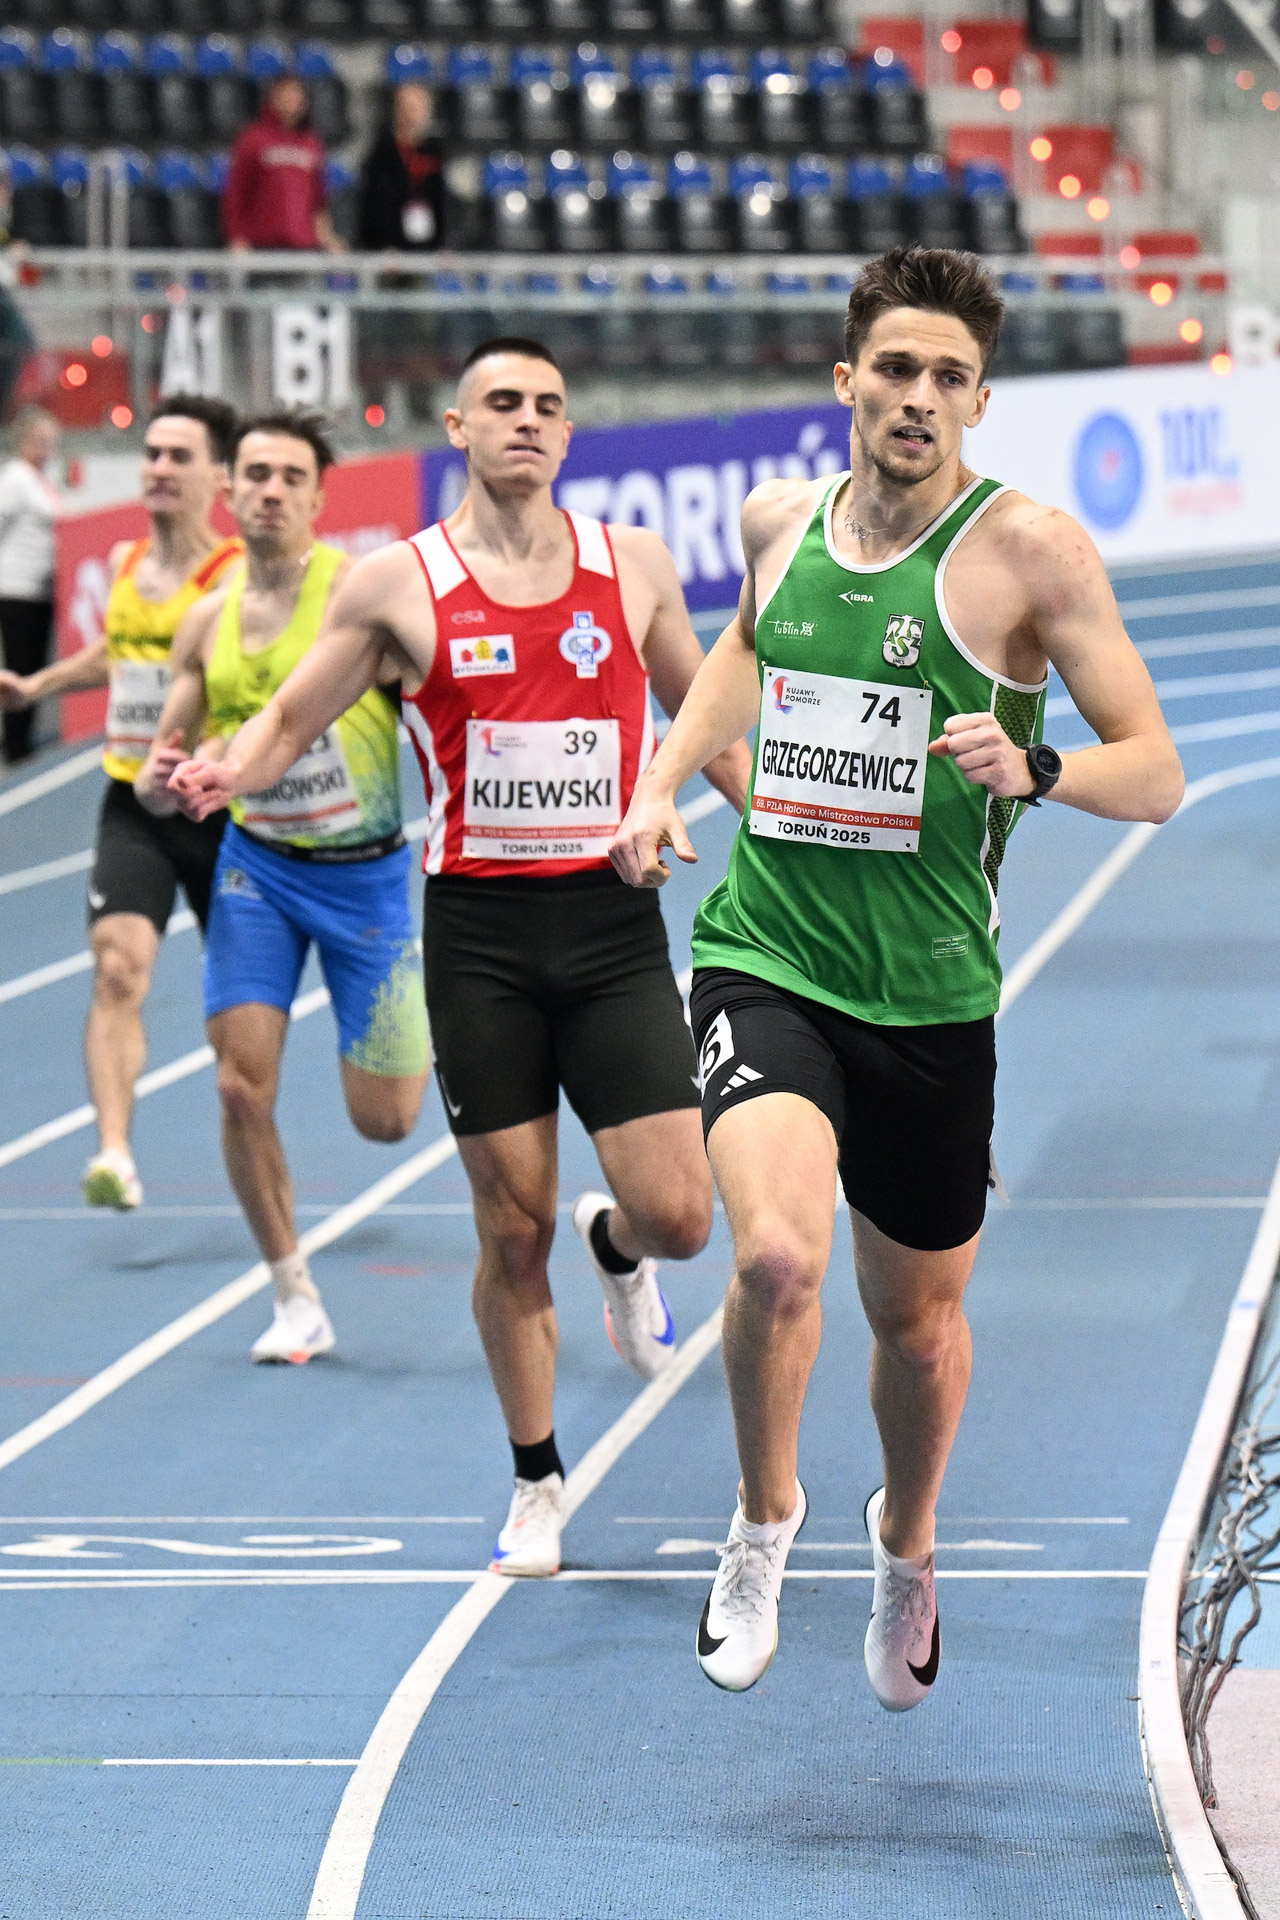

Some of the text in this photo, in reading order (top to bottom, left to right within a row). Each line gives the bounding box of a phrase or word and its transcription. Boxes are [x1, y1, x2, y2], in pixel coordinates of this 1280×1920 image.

[274, 303, 350, 408] B1
[785, 694, 822, 706] POMORZE
[786, 686, 816, 697] KUJAWY
[860, 691, 902, 728] 74
[564, 730, 598, 756] 39
[762, 738, 918, 794] GRZEGORZEWICZ
[472, 777, 612, 809] KIJEWSKI
[766, 800, 783, 812] PZLA
[783, 803, 816, 817] Halowe
[818, 808, 880, 825] Mistrzostwa
[882, 816, 914, 828] Polski
[777, 821, 871, 844] TORUŃ 2025
[552, 842, 584, 854] 2025
